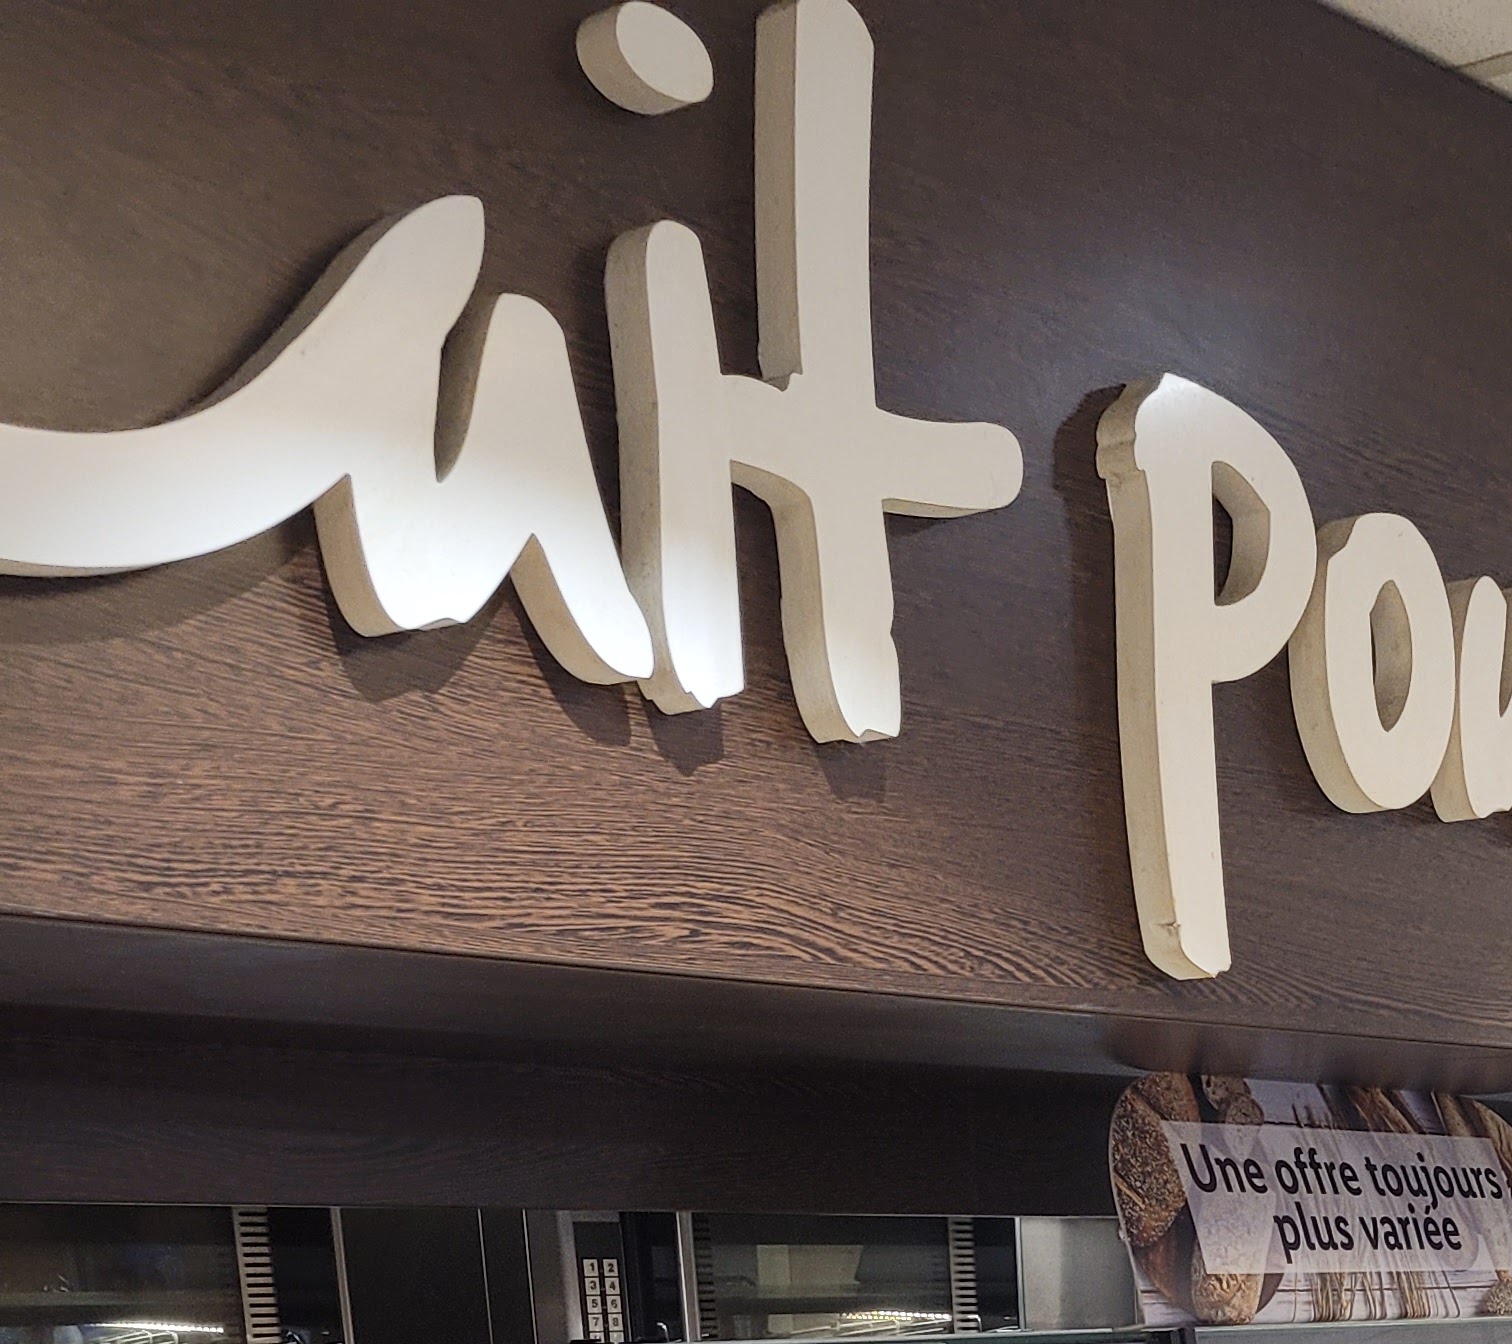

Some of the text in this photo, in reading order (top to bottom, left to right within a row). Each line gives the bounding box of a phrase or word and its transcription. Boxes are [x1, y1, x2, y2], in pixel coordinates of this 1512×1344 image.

[0, 0, 1023, 742] uit
[1179, 1142, 1503, 1209] Une offre toujours
[1273, 1200, 1463, 1264] plus variée
[589, 1262, 615, 1273] 1 2
[589, 1280, 616, 1291] 3 4
[591, 1298, 618, 1309] 5 6
[592, 1316, 619, 1327] 7 8
